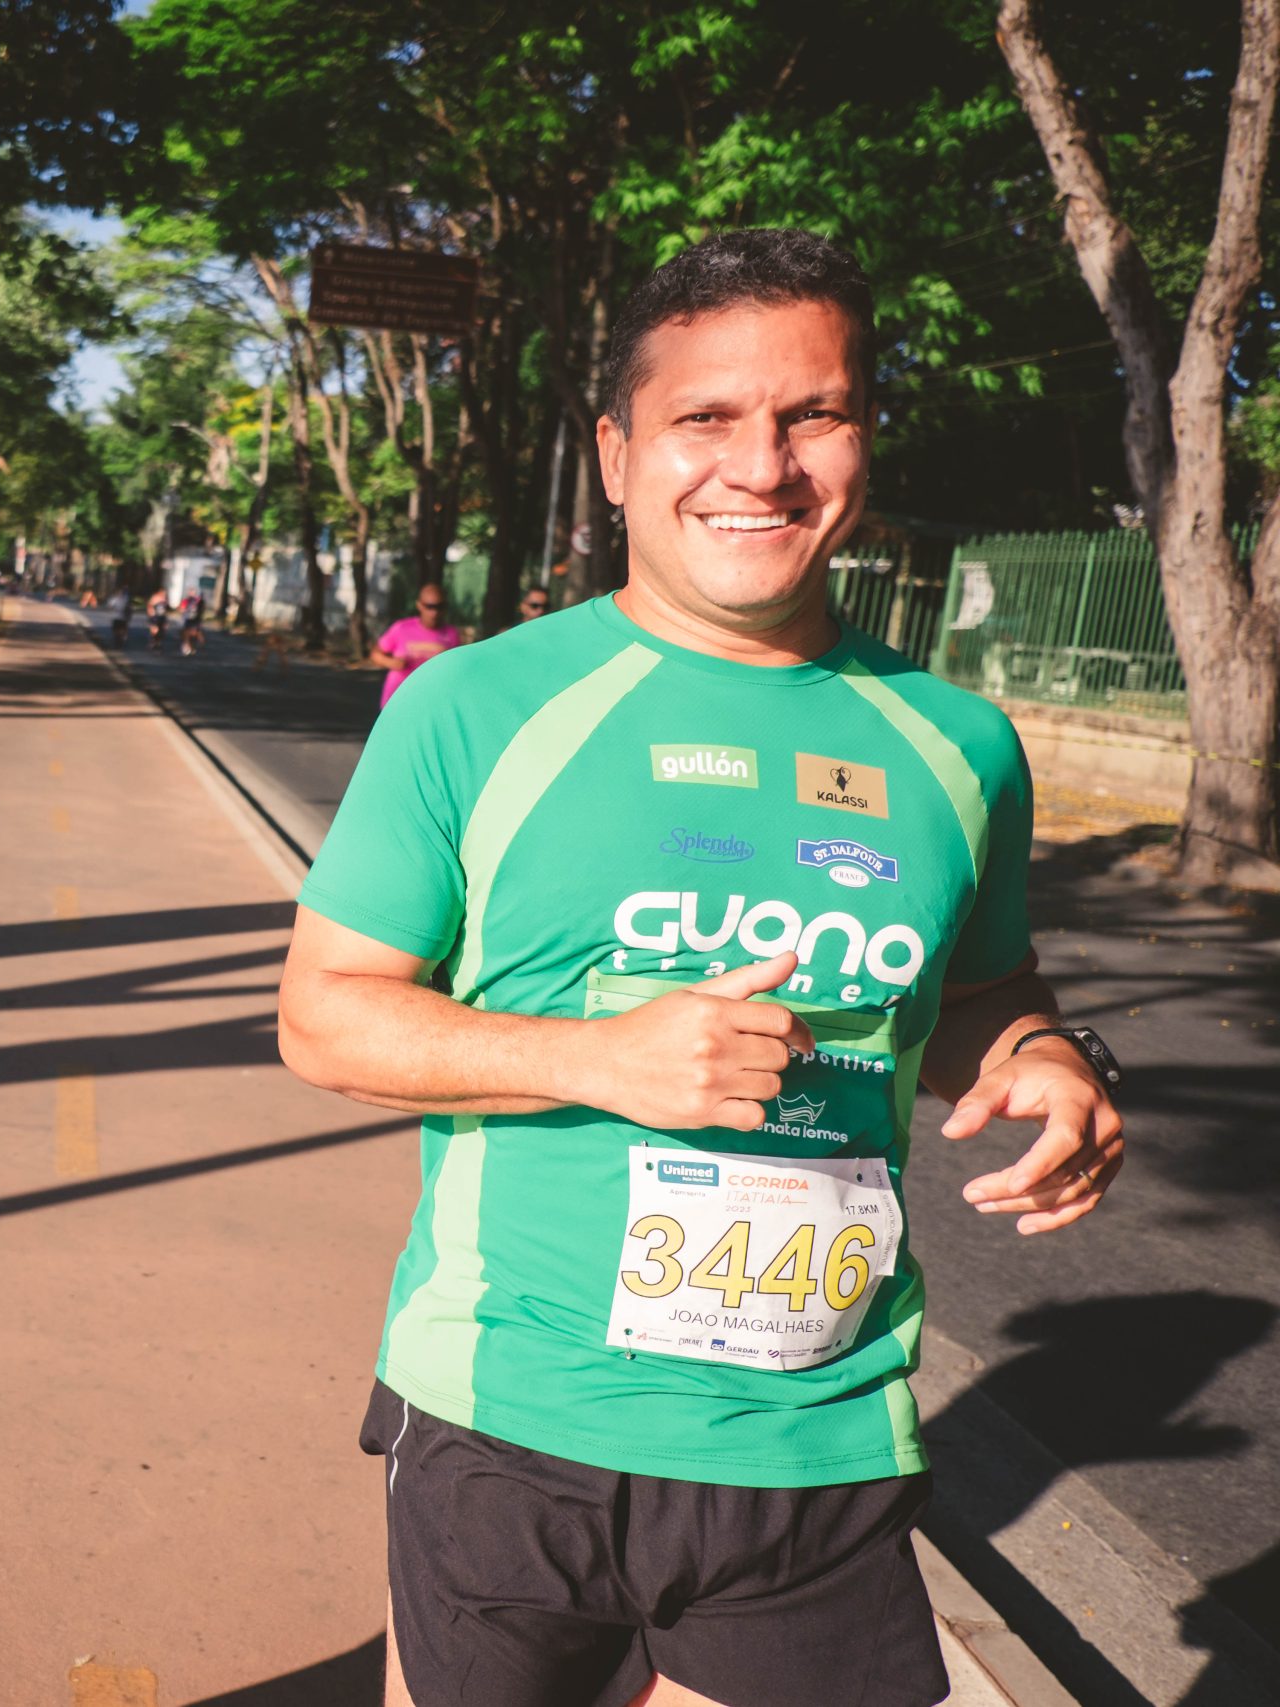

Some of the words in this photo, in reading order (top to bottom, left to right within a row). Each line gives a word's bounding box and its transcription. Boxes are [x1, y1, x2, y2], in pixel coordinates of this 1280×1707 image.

[661, 751, 748, 779] gullón
[817, 790, 868, 809] KALASSI
[659, 827, 747, 855] Splenda
[813, 848, 831, 861] ST.
[830, 845, 883, 871] DALFOUR
[833, 870, 866, 882] FRANCE
[593, 995, 604, 1005] 2
[789, 1047, 885, 1074] sportiva
[802, 1125, 848, 1143] lemos
[663, 1164, 713, 1178] Unimed
[727, 1174, 809, 1191] CORRIDA
[726, 1190, 792, 1204] ITATIAIA
[845, 1203, 880, 1216] 17.8KM
[880, 1235, 895, 1267] GUARDA
[621, 1214, 875, 1312] 3446
[668, 1309, 718, 1327] JOAO
[723, 1316, 825, 1334] MAGALHAES
[726, 1345, 760, 1355] GERDAU
